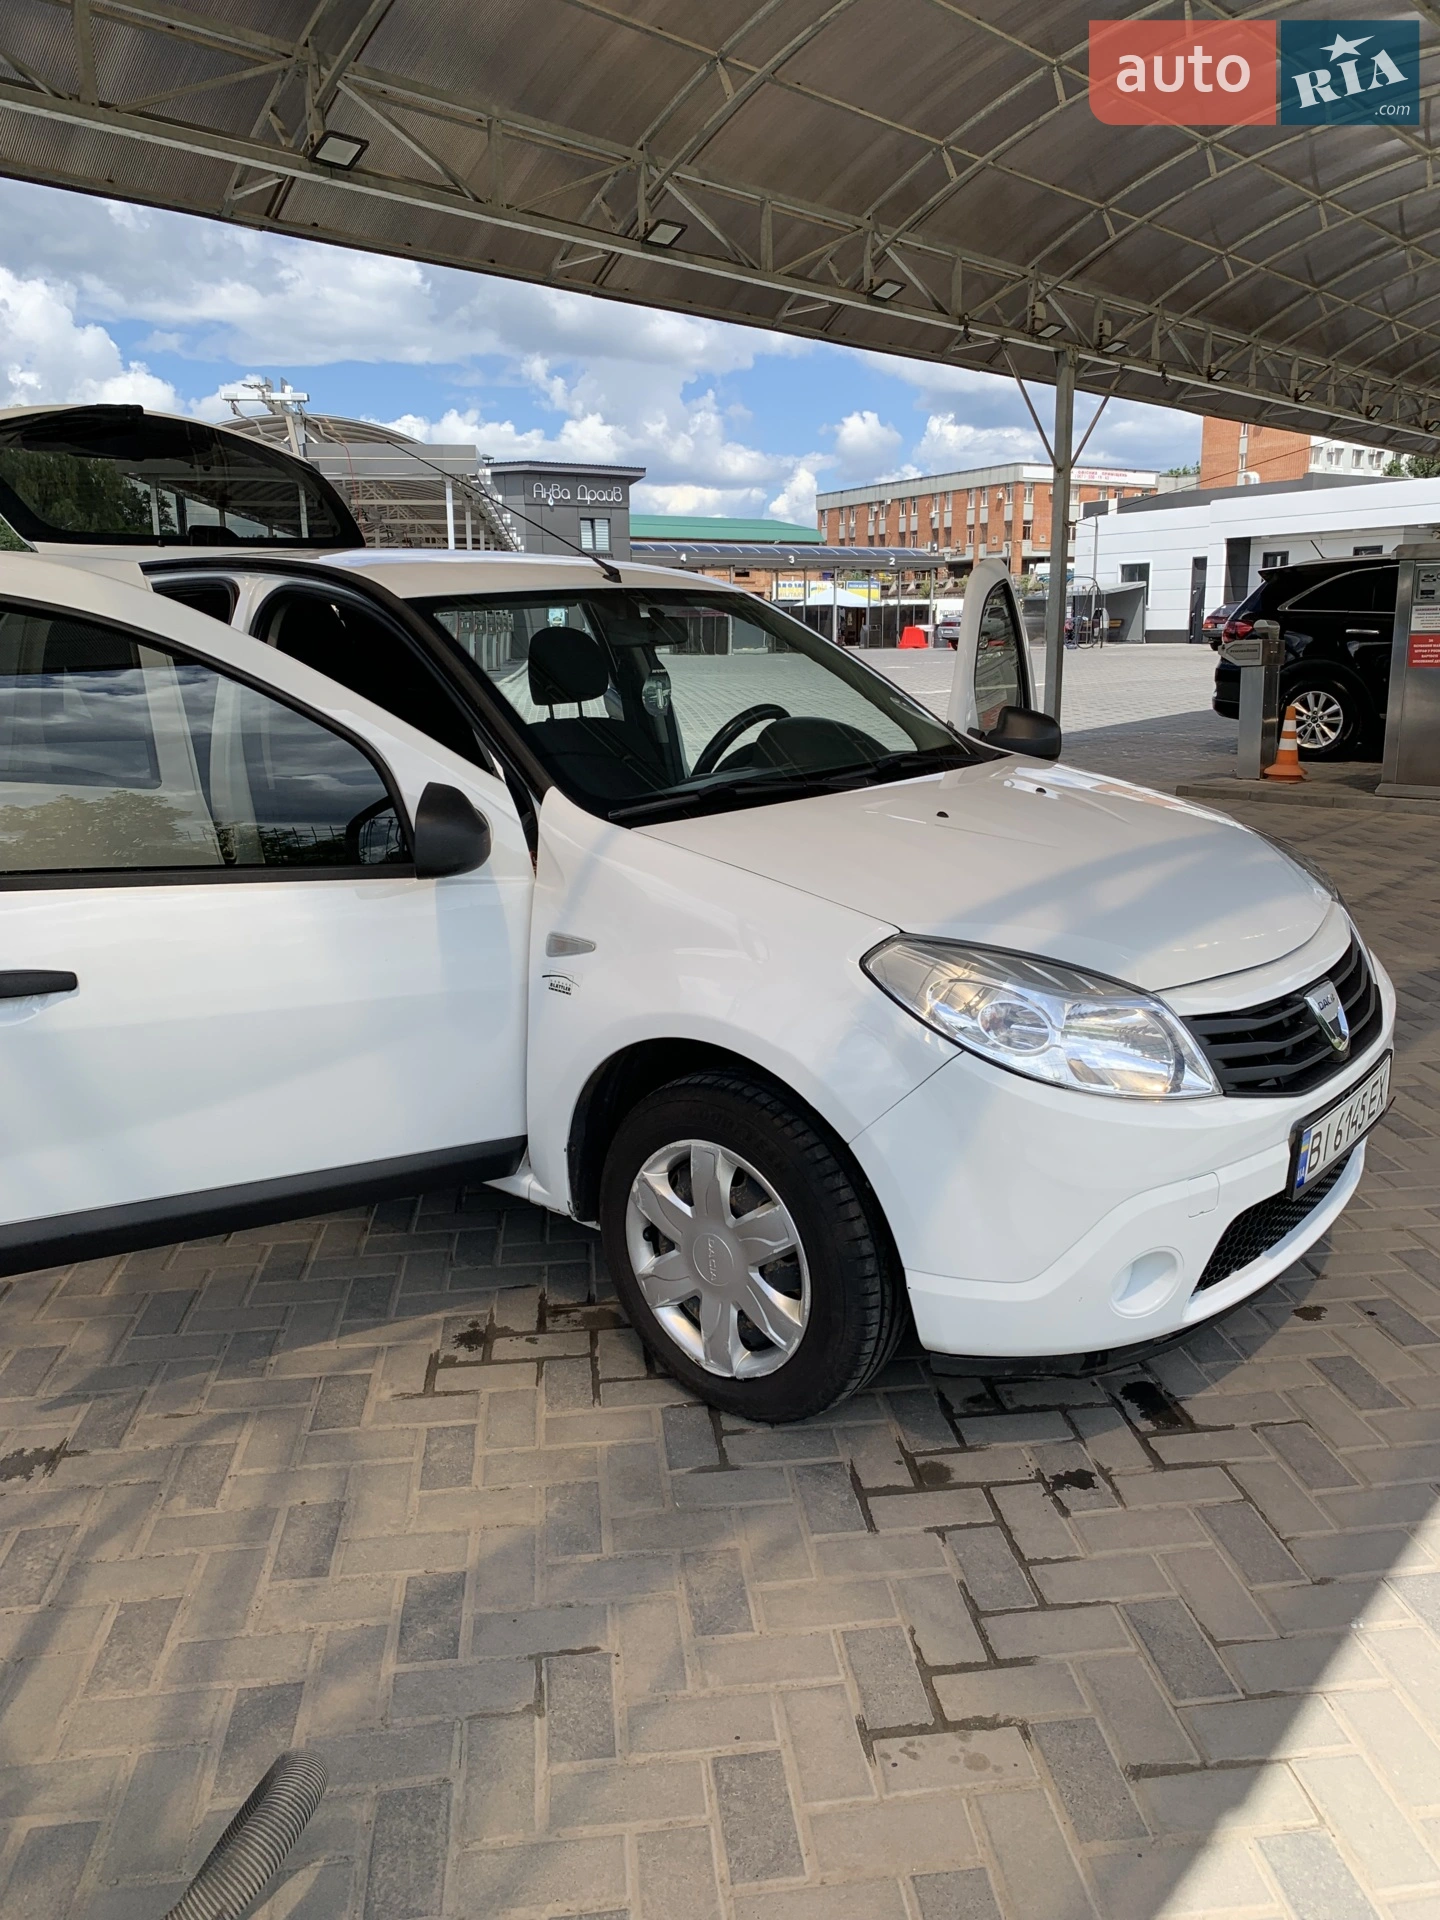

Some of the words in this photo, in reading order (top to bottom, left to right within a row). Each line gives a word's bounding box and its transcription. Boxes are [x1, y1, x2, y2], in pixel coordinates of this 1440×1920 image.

[533, 482, 571, 502] Аква
[576, 484, 623, 505] Драйв
[933, 543, 938, 551] 1
[680, 553, 686, 563] 4
[788, 556, 795, 564] 3
[889, 557, 896, 566] 2
[1307, 1123, 1331, 1175] BI
[1333, 1094, 1367, 1151] 6145
[1367, 1068, 1388, 1119] EX
[706, 1237, 718, 1281] DACIA
